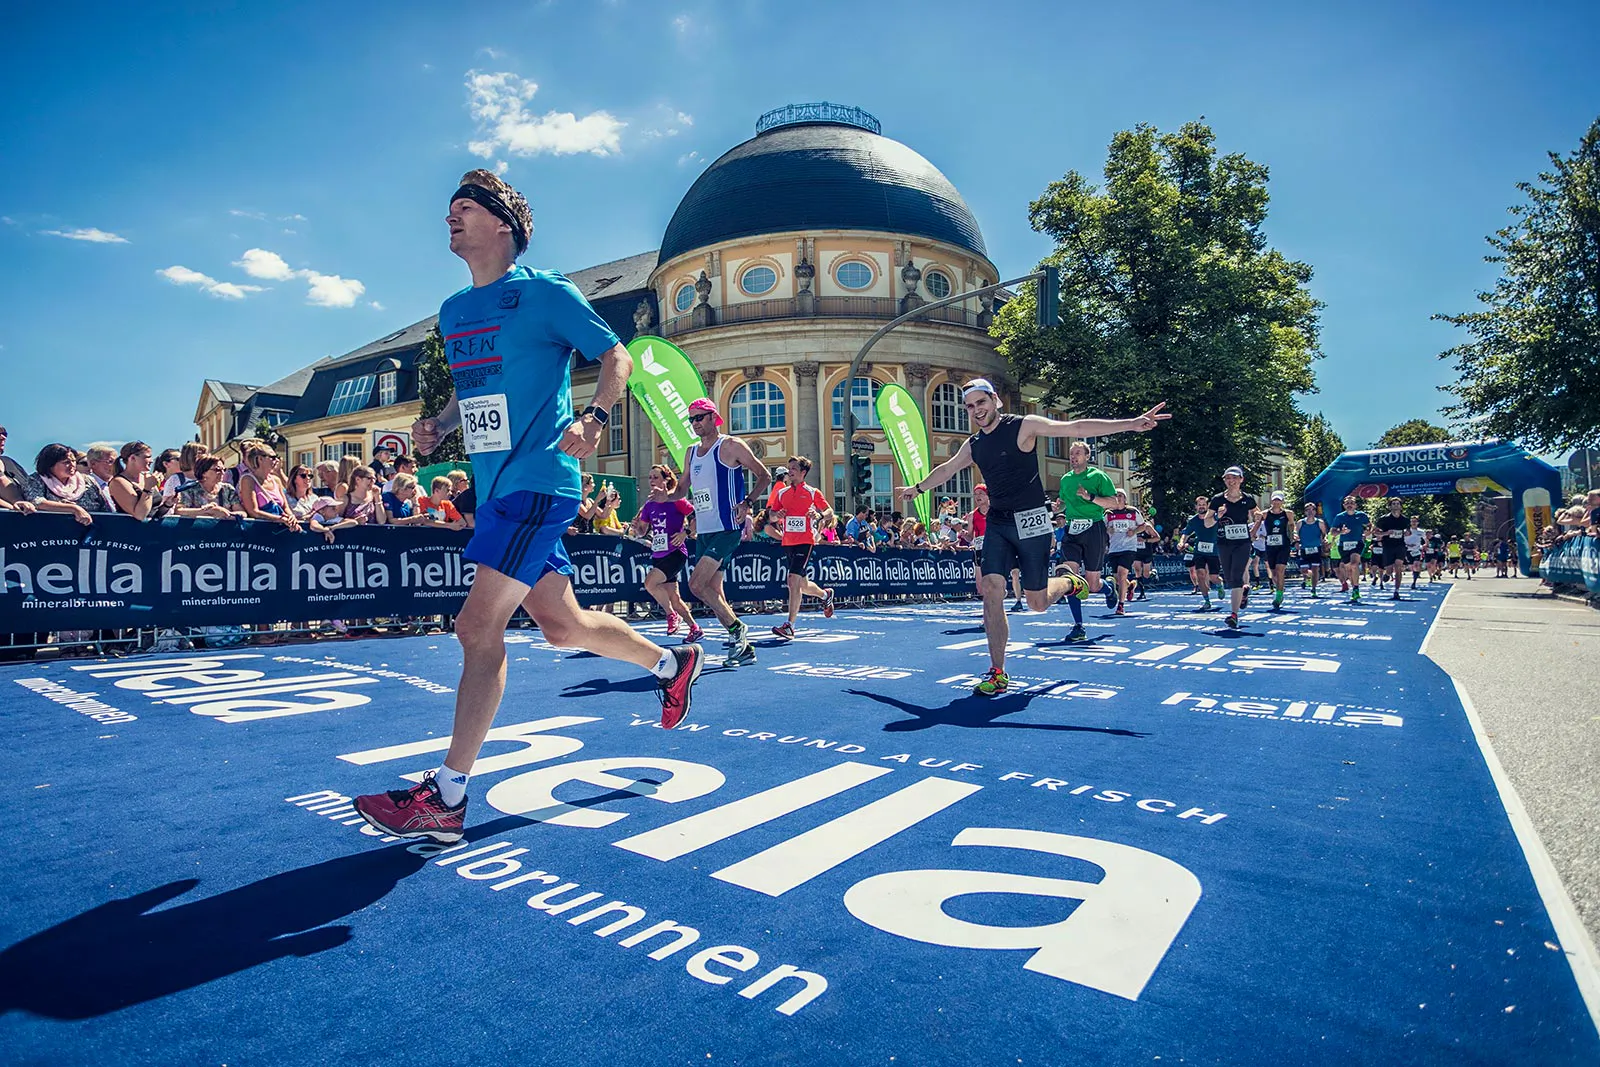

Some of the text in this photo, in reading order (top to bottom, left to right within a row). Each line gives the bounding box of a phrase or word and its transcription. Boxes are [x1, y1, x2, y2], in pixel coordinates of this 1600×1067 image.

[464, 410, 502, 434] 7849
[1369, 447, 1449, 466] ERDINGER
[1369, 461, 1470, 475] ALKOHOLFREI
[1020, 513, 1047, 529] 2287
[106, 541, 142, 552] FRISCH
[178, 544, 196, 552] VON
[248, 544, 275, 553] FRISCH
[304, 545, 319, 553] VON
[362, 545, 386, 554] FRISCH
[0, 547, 143, 594] hella
[161, 549, 277, 593] hella
[291, 550, 389, 590] hella
[400, 551, 478, 587] hella
[731, 558, 772, 582] hella
[819, 559, 853, 580] hella
[853, 560, 883, 581] hella
[885, 560, 911, 580] hella
[911, 561, 937, 580] hella
[936, 561, 961, 580] hella
[22, 598, 125, 609] mineralbrunnen
[181, 596, 261, 606] mineralbrunnen
[307, 592, 376, 602] mineralbrunnen
[413, 590, 469, 598] mineralbrunnen
[767, 662, 913, 680] hella
[70, 653, 380, 723] hella
[1161, 692, 1404, 728] hella
[1189, 707, 1361, 728] mineralbrunnen
[722, 728, 867, 754] GRUND
[880, 752, 984, 775] AUF
[998, 771, 1228, 825] FRISCH
[336, 716, 1202, 1001] hella
